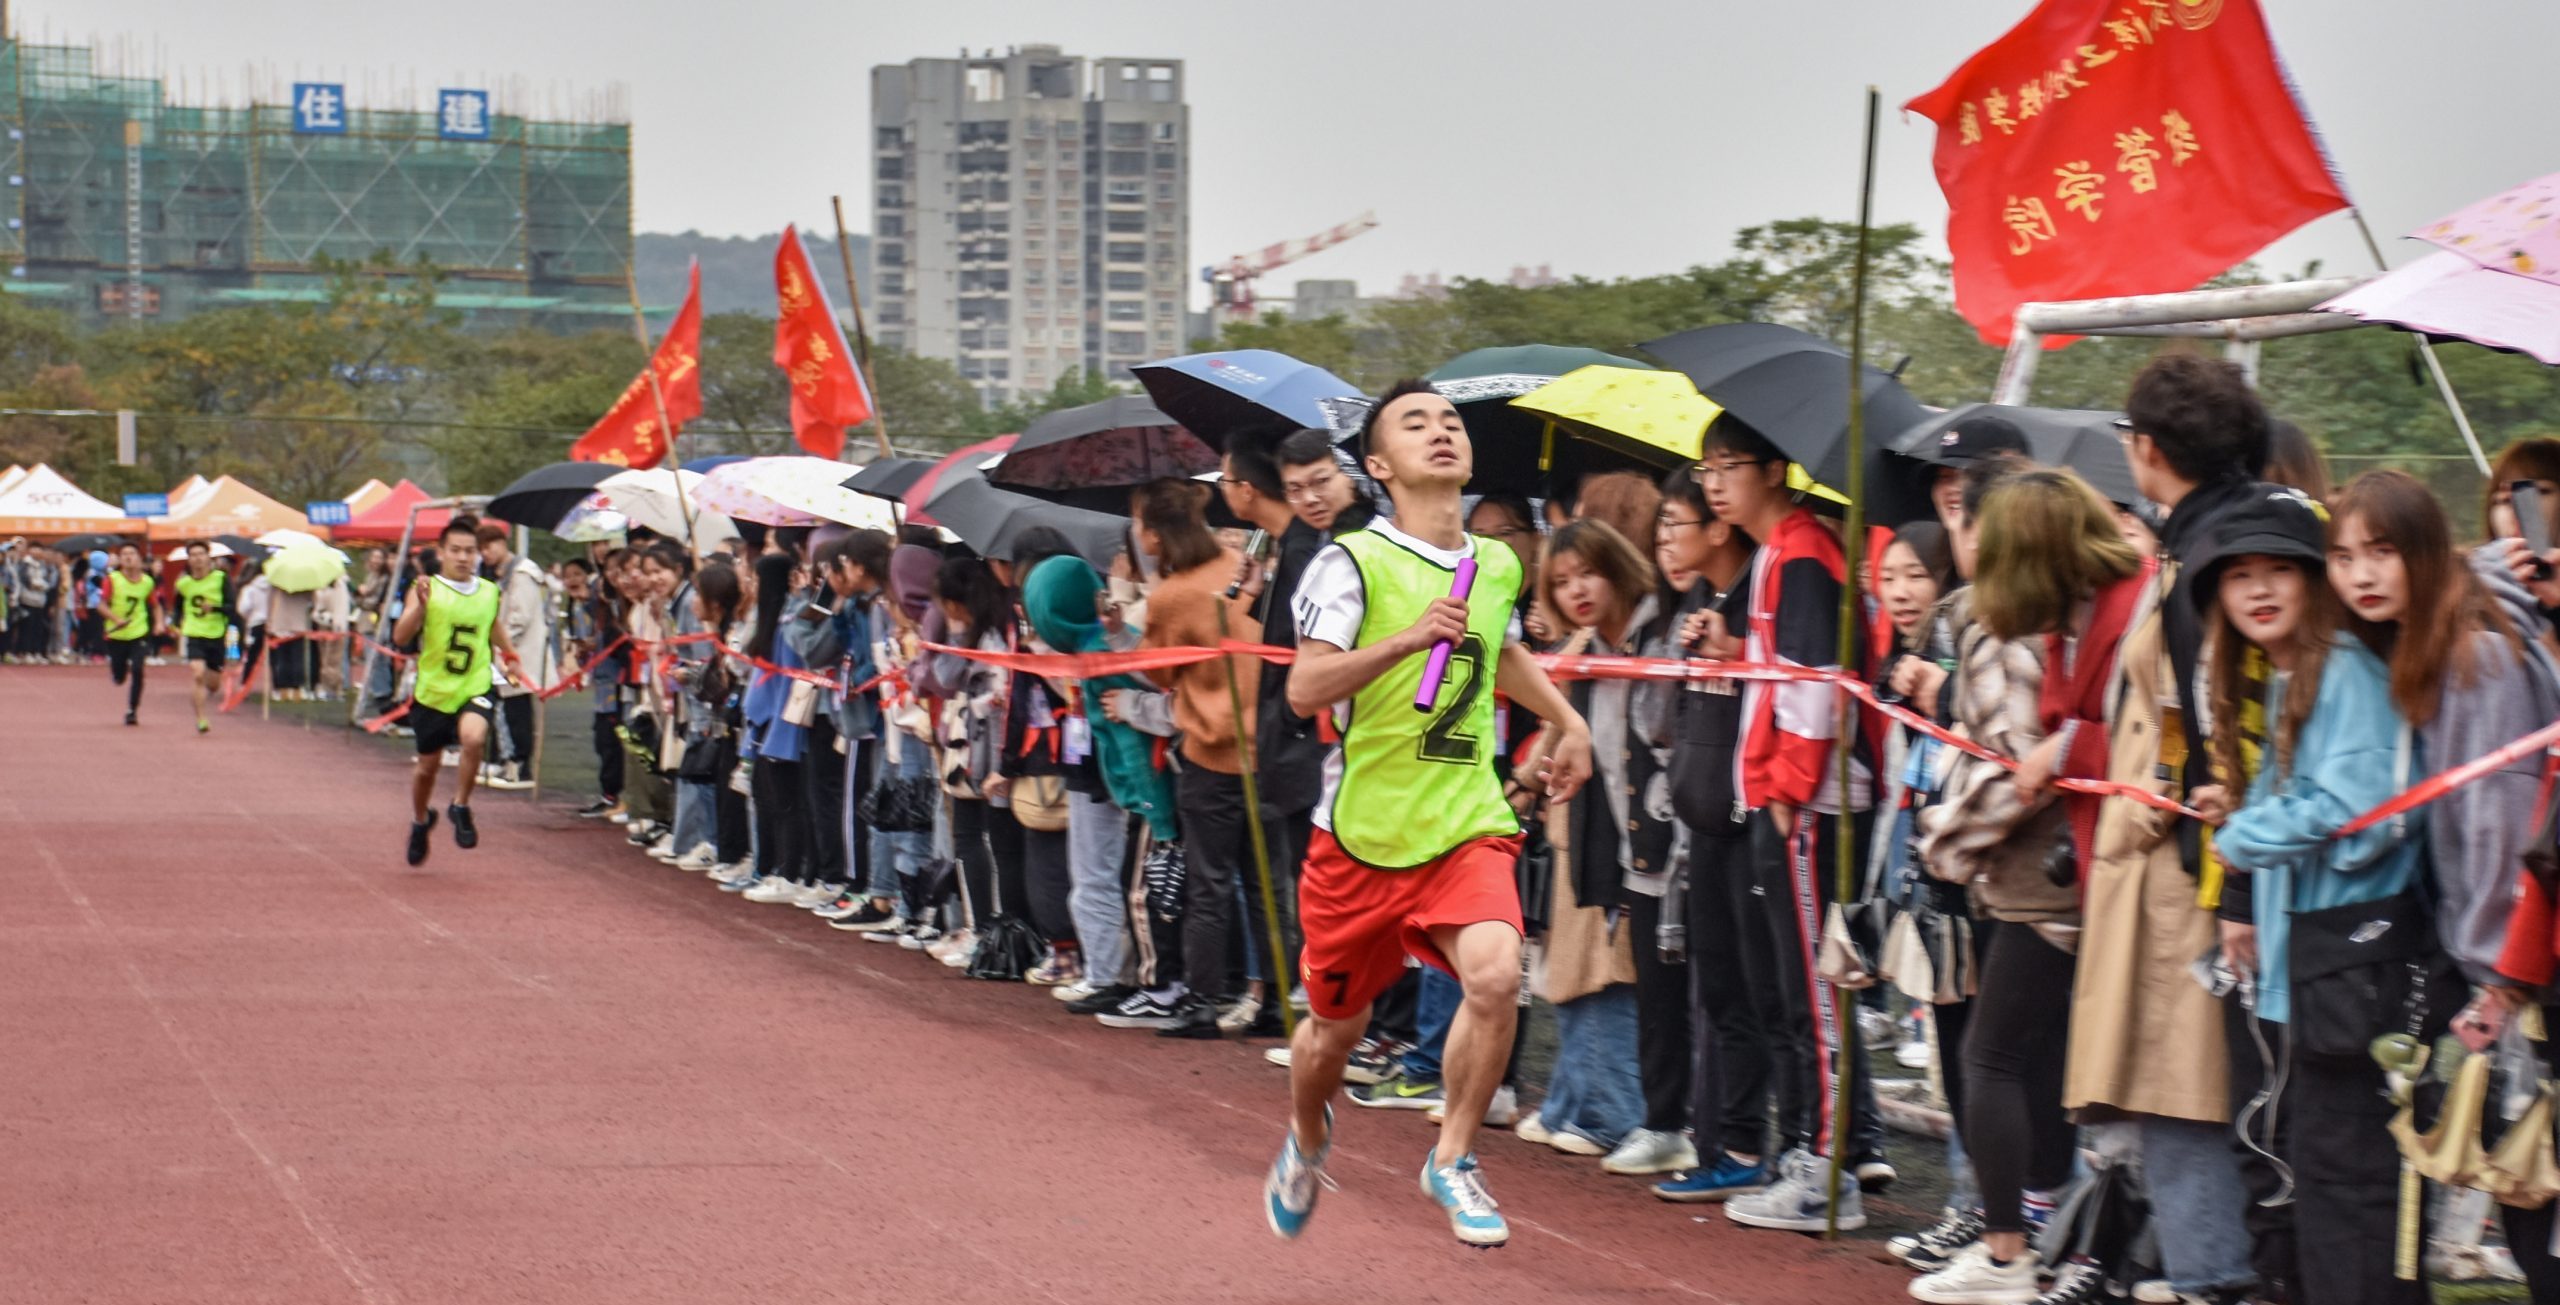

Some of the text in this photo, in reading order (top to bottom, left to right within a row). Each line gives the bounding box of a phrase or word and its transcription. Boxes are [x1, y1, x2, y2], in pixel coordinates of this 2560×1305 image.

[126, 596, 138, 617] 7
[446, 624, 477, 675] 5
[1417, 631, 1489, 766] 2
[1323, 971, 1352, 1007] 7
